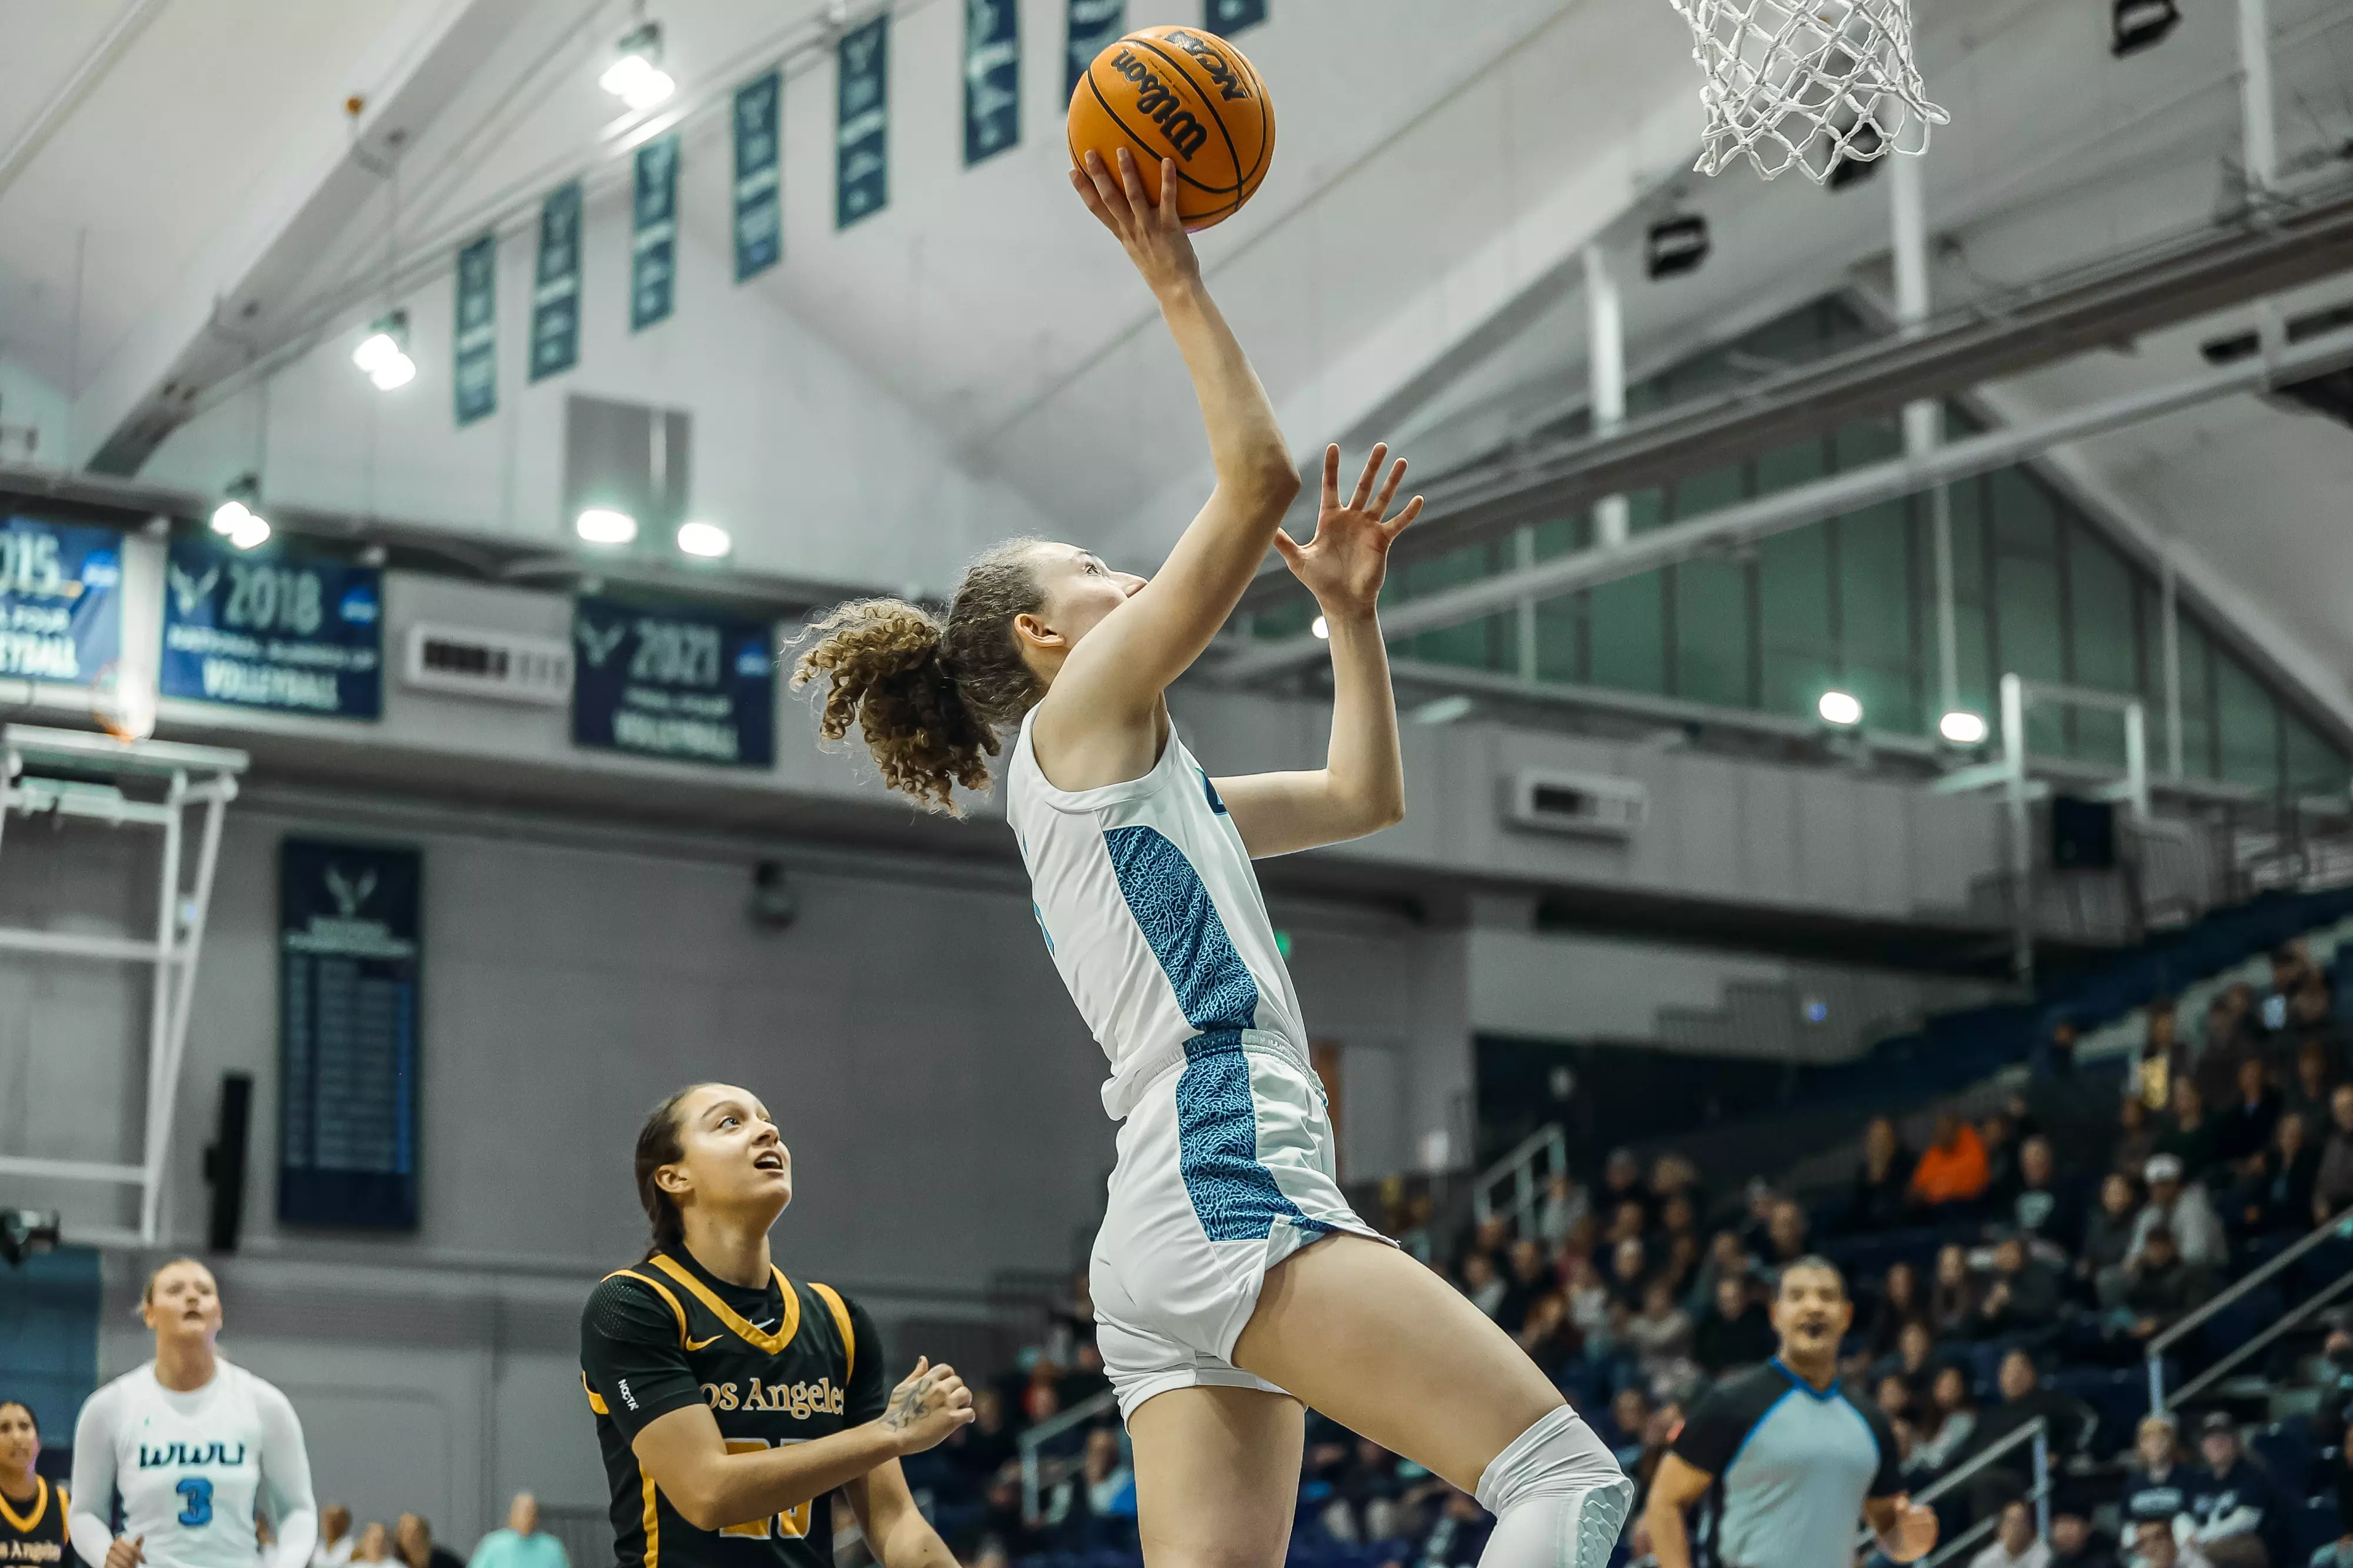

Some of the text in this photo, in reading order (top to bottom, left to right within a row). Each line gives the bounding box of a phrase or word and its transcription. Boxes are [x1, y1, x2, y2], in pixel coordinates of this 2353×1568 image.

[1110, 49, 1208, 162] Wilson
[225, 564, 322, 634] 2018
[203, 658, 339, 710] VOLLEYBALL
[618, 1379, 640, 1411] NOCTA
[700, 1377, 845, 1420] os Angele
[139, 1442, 246, 1468] WWU
[176, 1477, 214, 1527] 3
